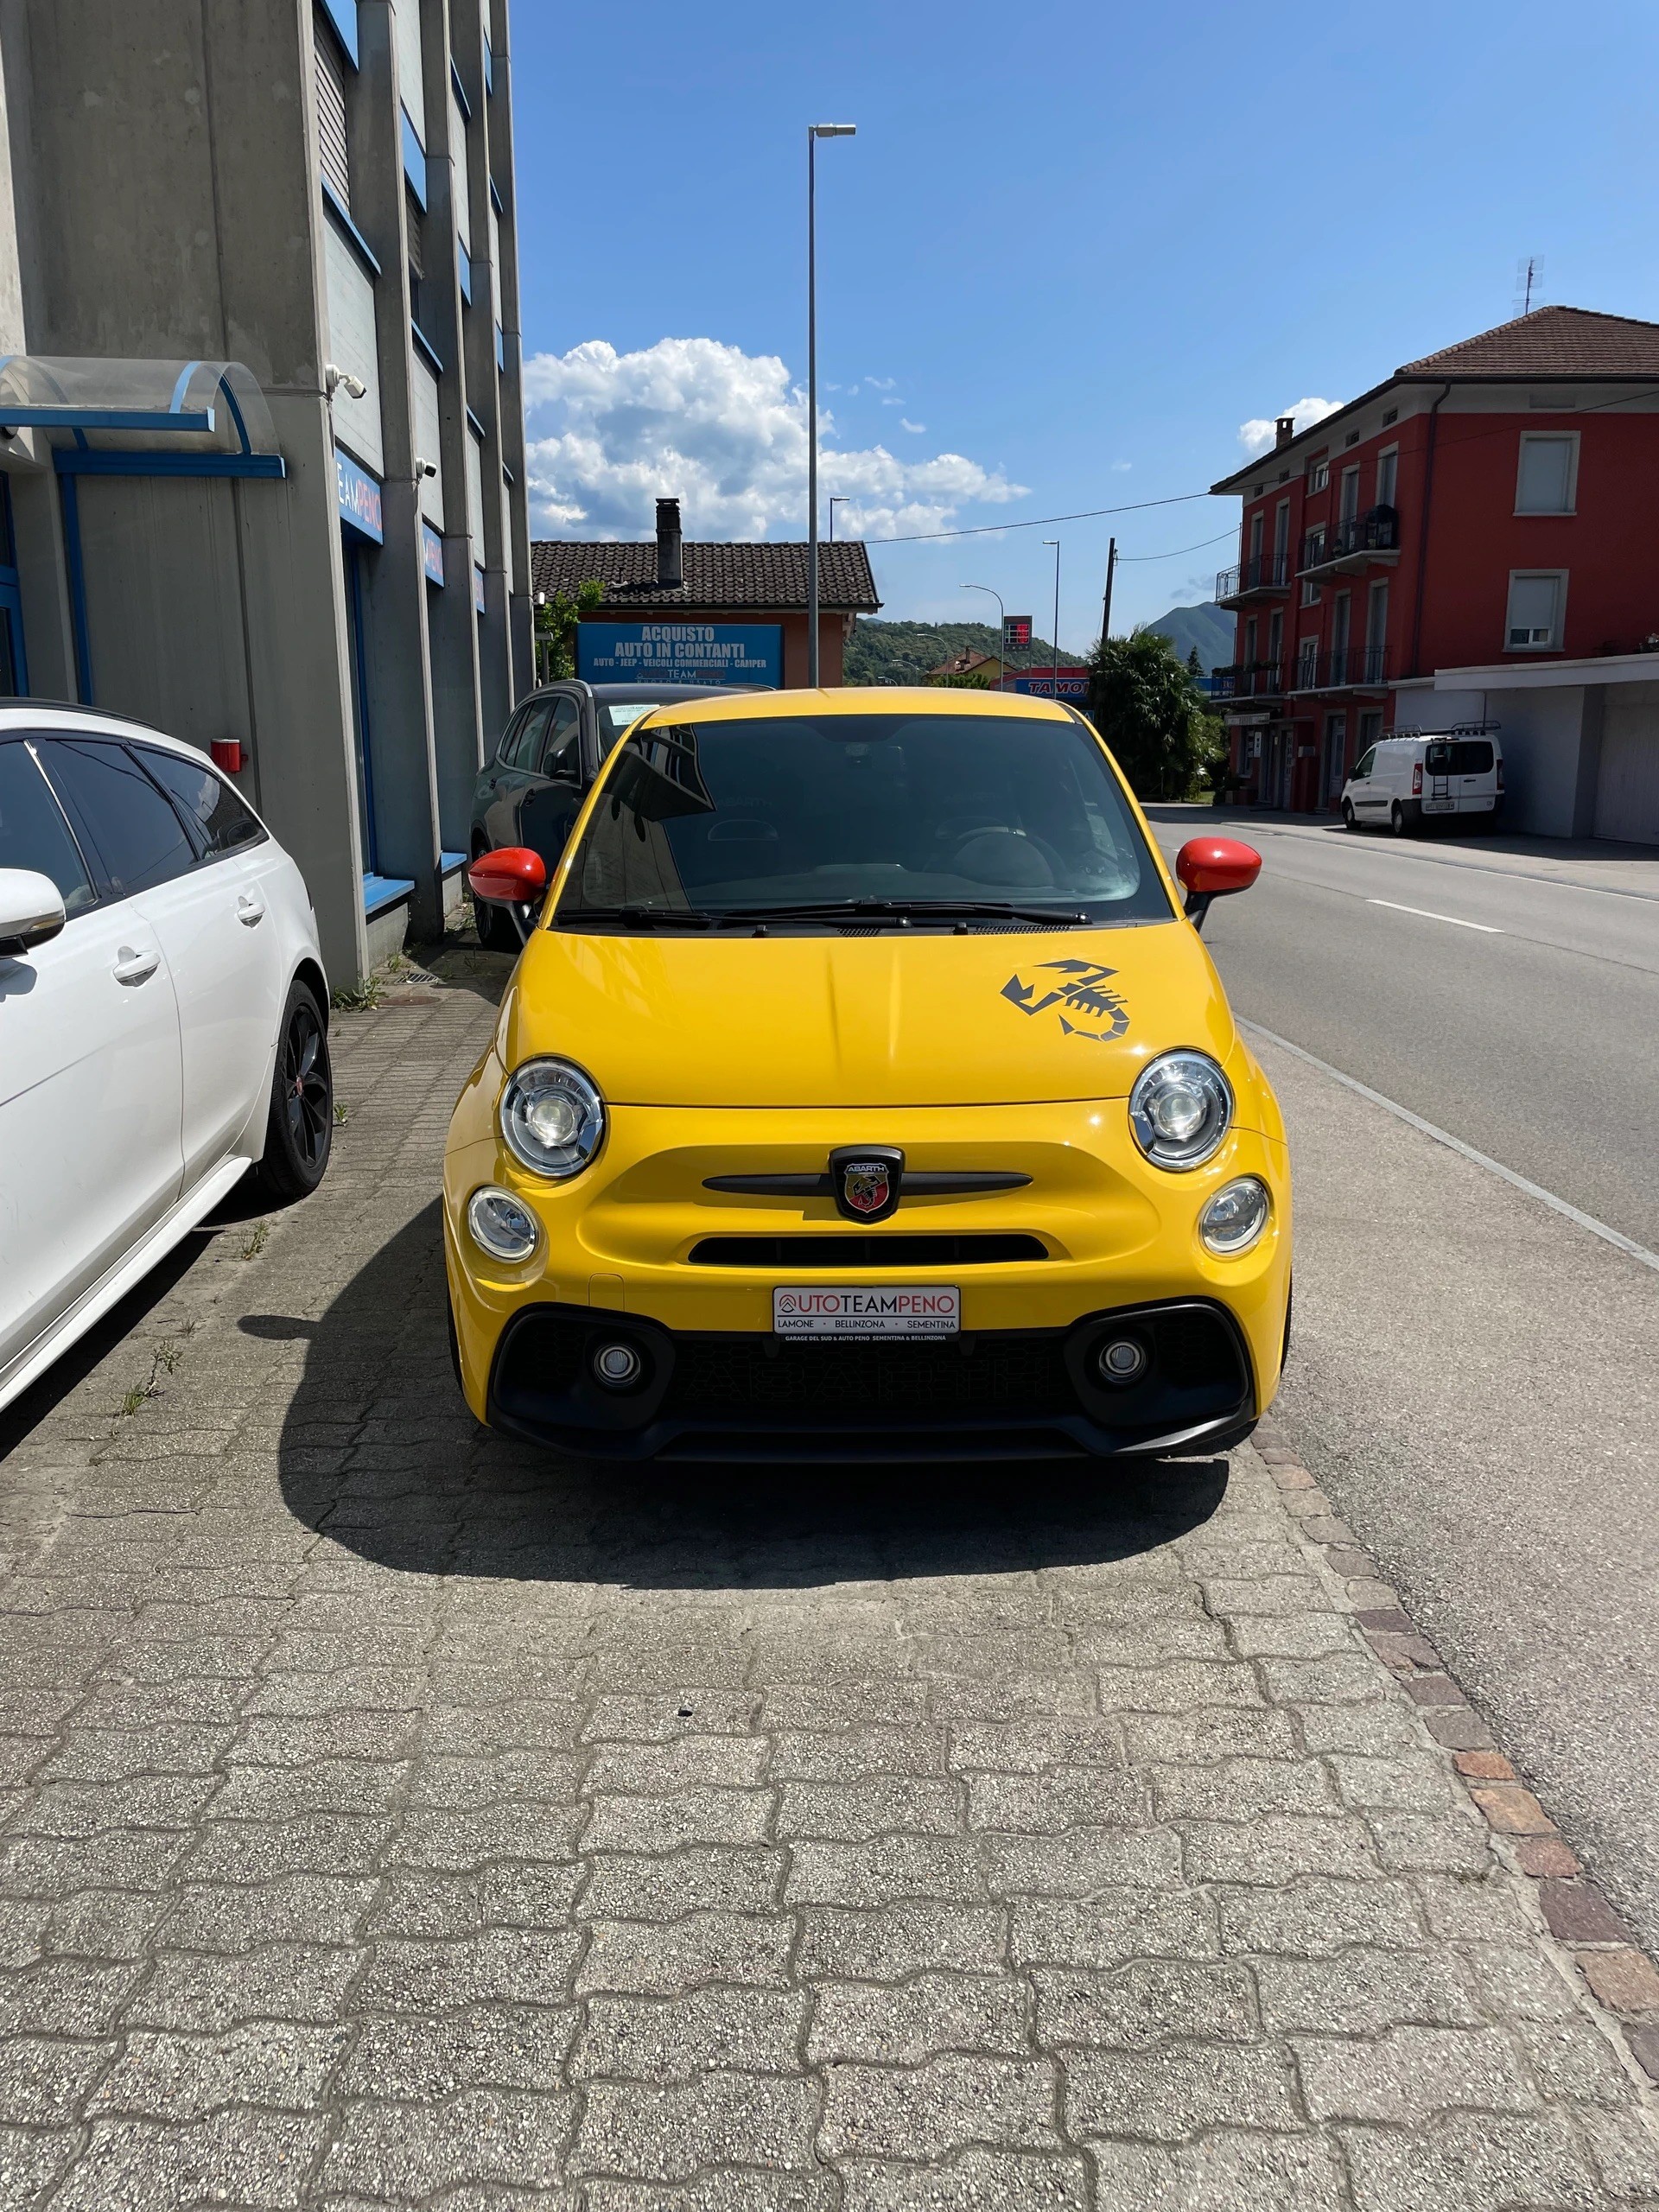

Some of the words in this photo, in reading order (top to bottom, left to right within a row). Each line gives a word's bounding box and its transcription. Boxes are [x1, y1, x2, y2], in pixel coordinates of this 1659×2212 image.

[642, 626, 715, 642] ACQUISTO
[614, 642, 653, 658] AUTO
[657, 643, 671, 658] IN
[675, 643, 745, 658] CONTANTI
[594, 658, 614, 667] AUTO
[620, 658, 638, 667] JEEP
[643, 658, 673, 667] VEICOLI
[674, 658, 728, 668] COMMERCIALI
[734, 659, 766, 668] CAMPER
[778, 1319, 814, 1328] LAMONE
[835, 1319, 886, 1328] BELLINZONA
